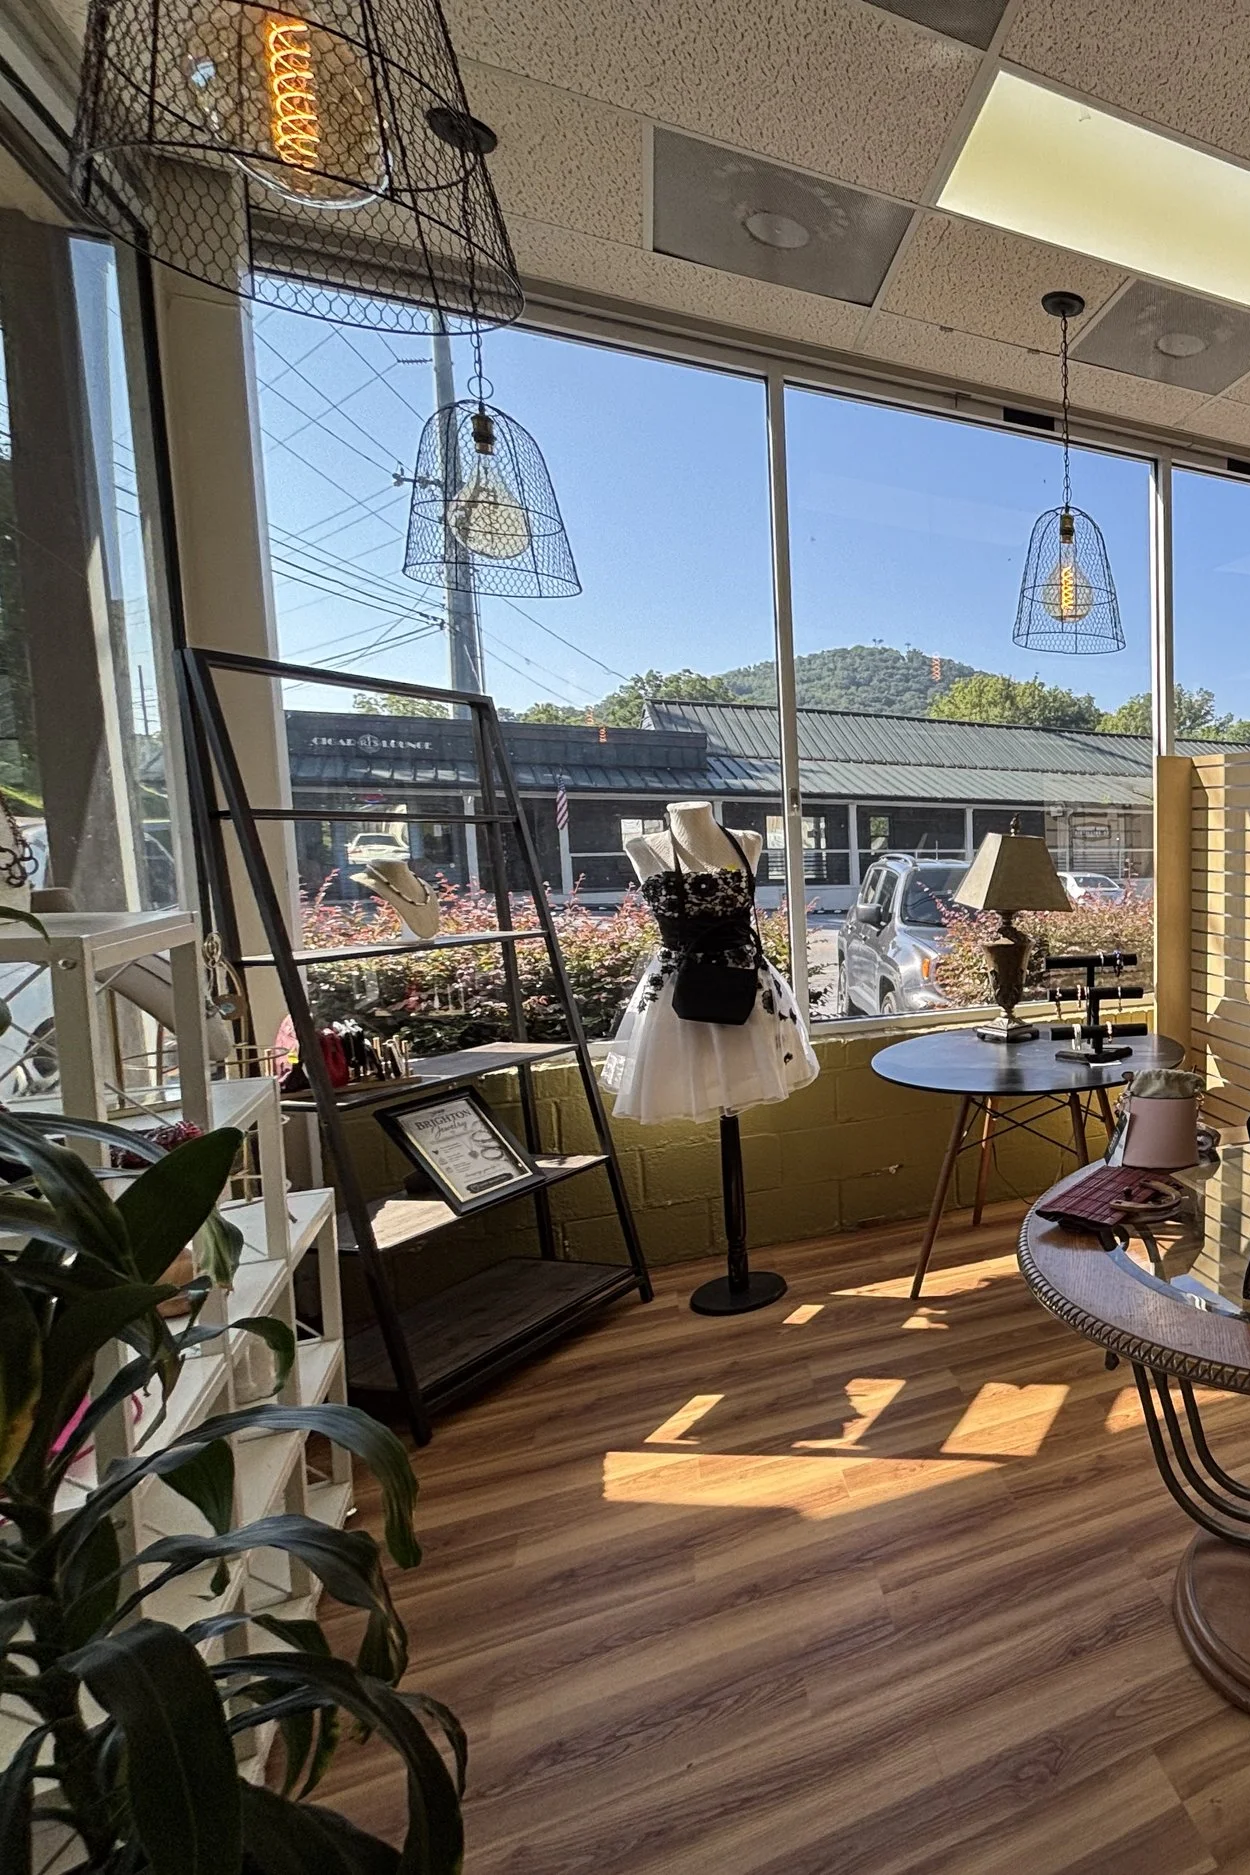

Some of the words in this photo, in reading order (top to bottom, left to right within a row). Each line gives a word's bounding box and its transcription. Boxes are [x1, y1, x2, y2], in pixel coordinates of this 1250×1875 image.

[310, 737, 356, 747] CIGAR
[381, 739, 434, 750] LOUNGE
[415, 1109, 472, 1131] BRIGHTON
[432, 1120, 467, 1140] Jewelry
